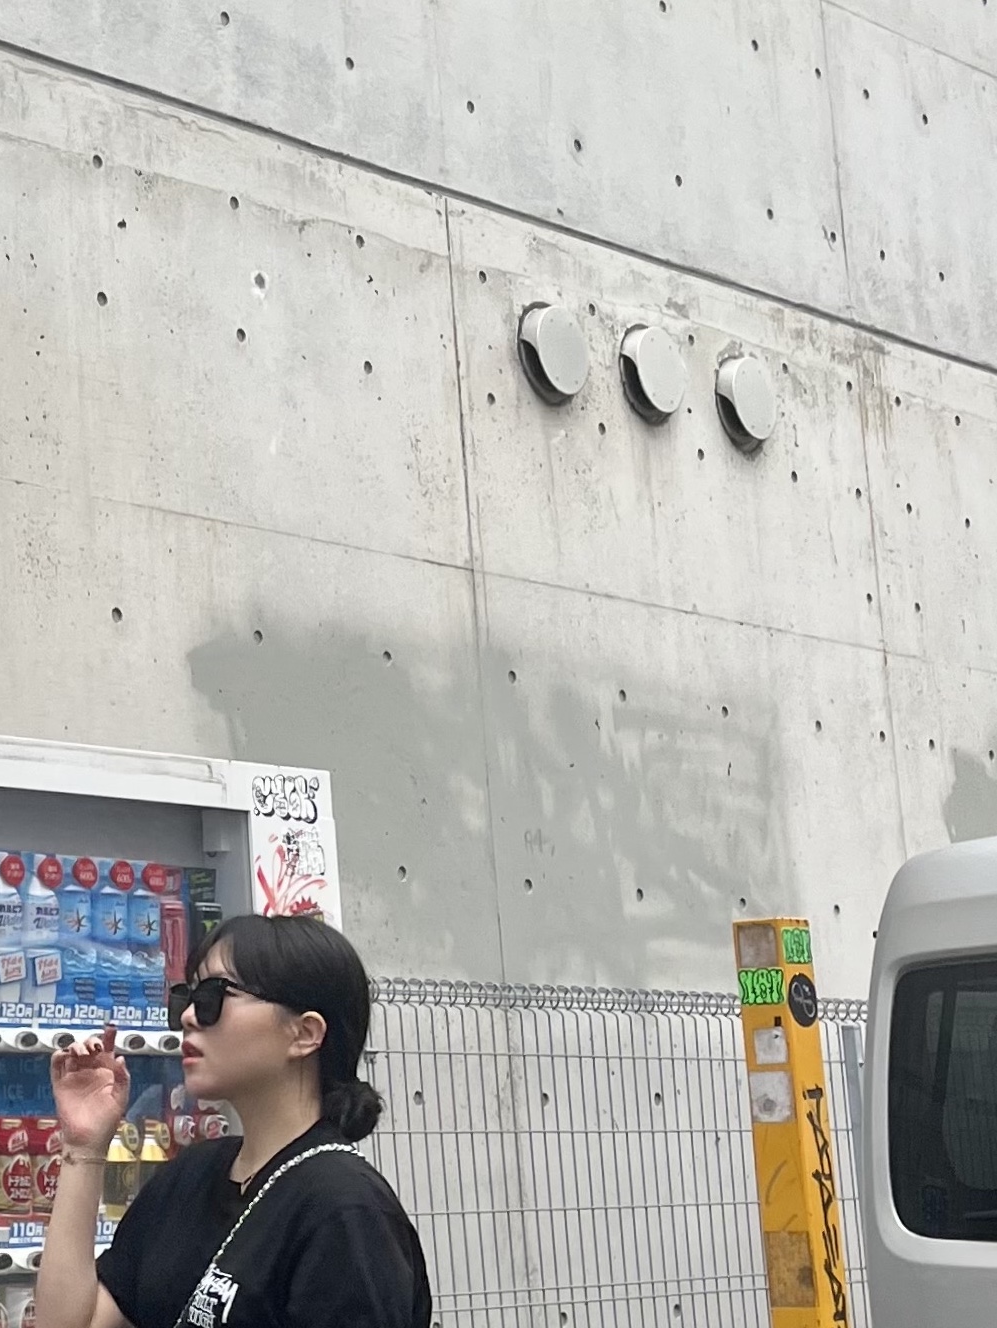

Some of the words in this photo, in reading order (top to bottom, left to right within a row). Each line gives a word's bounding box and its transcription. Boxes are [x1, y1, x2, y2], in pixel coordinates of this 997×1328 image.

[1, 1002, 33, 1018] 120円
[41, 1003, 72, 1018] 120円
[74, 1004, 104, 1019] 120円
[112, 1005, 142, 1020] 120円
[12, 1223, 43, 1236] 110円
